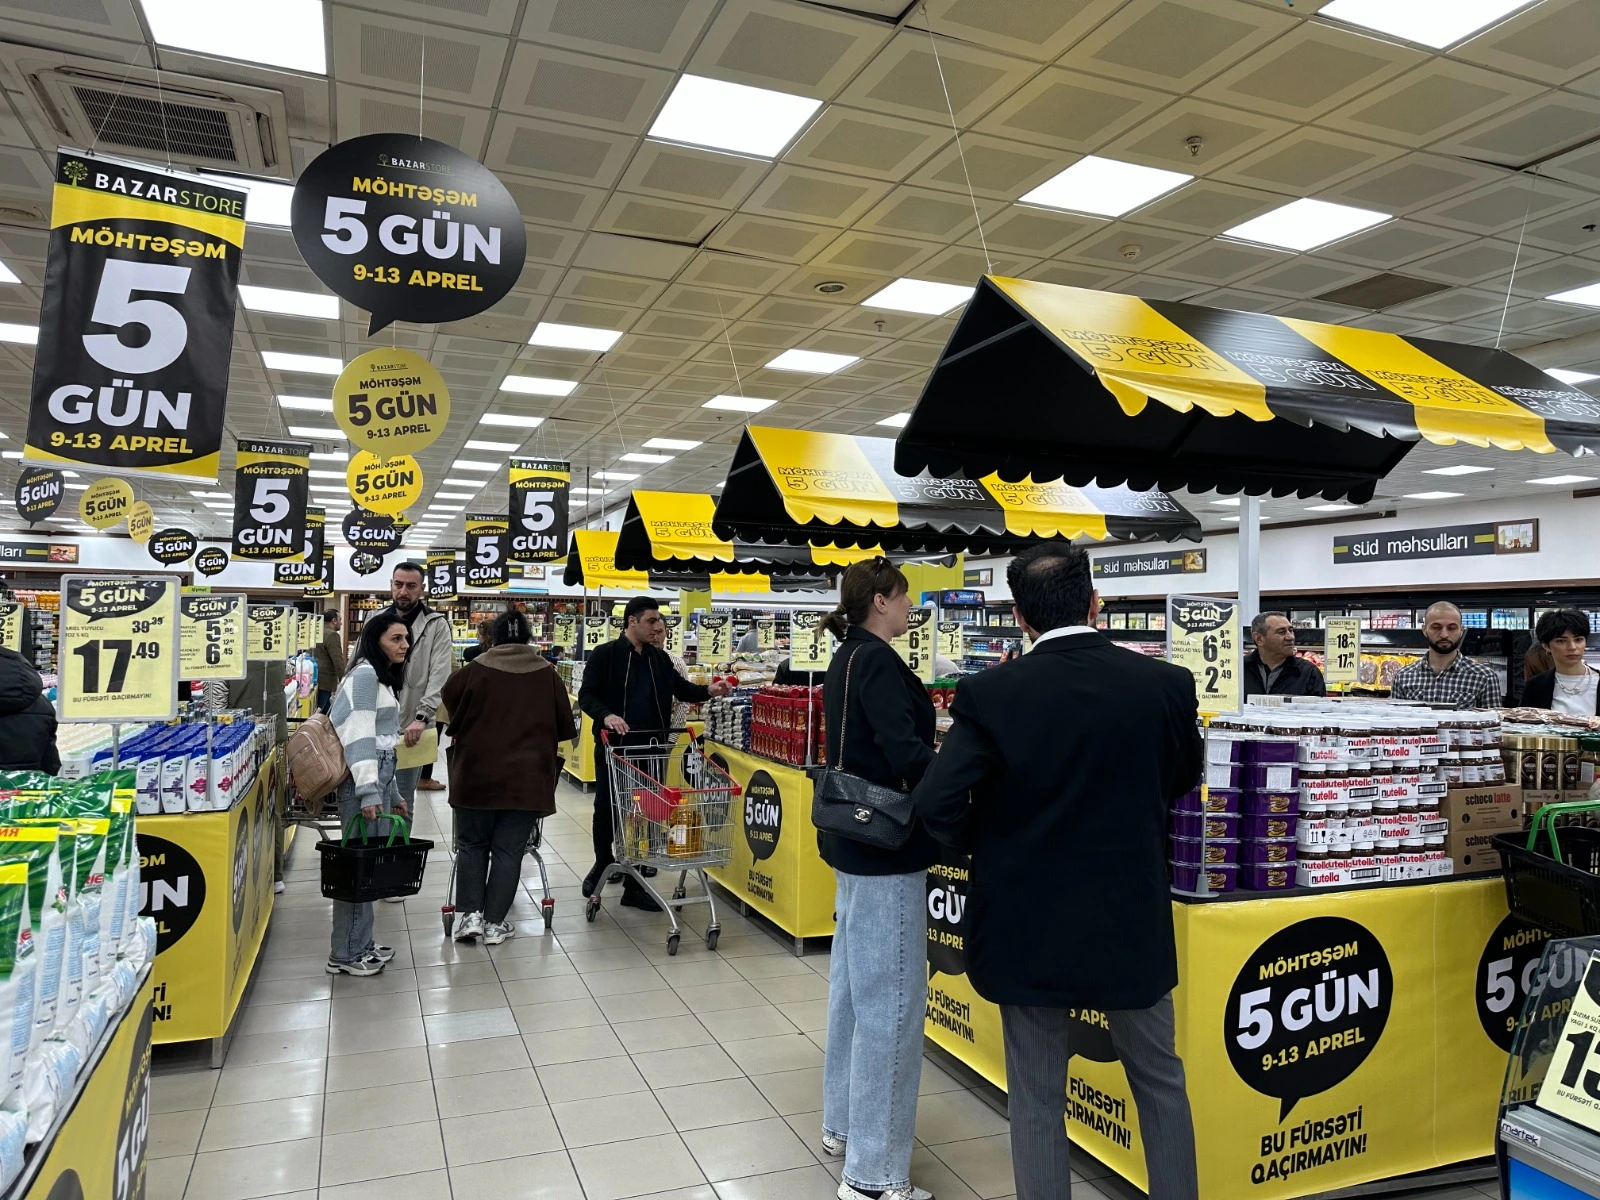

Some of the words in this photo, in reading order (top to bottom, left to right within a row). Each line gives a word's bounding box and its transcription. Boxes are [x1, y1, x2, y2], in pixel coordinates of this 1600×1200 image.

[391, 157, 452, 174] BAZARSTORE
[95, 172, 243, 218] BAZARSTORE
[352, 176, 478, 208] MÖHTƏŞƏM
[320, 196, 368, 255] 5
[379, 210, 501, 265] GÜN
[70, 226, 227, 260] MÖHTƏŞƏM
[353, 264, 400, 284] 9-13
[408, 269, 483, 292] APREL
[82, 258, 192, 374] 5
[1080, 341, 1124, 362] 5
[359, 376, 421, 390] MÖHTƏŞƏM
[1245, 363, 1288, 383] 5
[48, 379, 192, 431] GÜN
[348, 394, 372, 427] 5
[375, 390, 438, 421] GÜN
[366, 427, 390, 440] 9-13
[394, 423, 431, 437] APREL
[50, 430, 102, 449] 9-13
[109, 433, 194, 454] APREL
[251, 444, 309, 457] BAZARSTORE
[243, 466, 303, 476] MÖHTƏŞƏM
[355, 473, 370, 495] 5
[372, 470, 414, 490] GÜN
[515, 481, 565, 490] MÖHTƏŞƏM
[786, 476, 808, 491] 5
[813, 478, 880, 494] GÜN
[899, 485, 919, 499] 5
[923, 484, 985, 501] GÜN
[20, 486, 30, 506] 5
[31, 481, 60, 501] GÜN
[250, 478, 290, 523] 5
[364, 494, 380, 503] 9-13
[382, 490, 407, 500] APREL
[1001, 492, 1023, 506] 5
[1026, 492, 1086, 508] GÜN
[85, 501, 95, 516] 5
[97, 496, 127, 512] GÜN
[104, 511, 122, 519] APREL
[521, 491, 555, 531] 5
[130, 521, 136, 532] 5
[136, 516, 152, 529] GÜN
[348, 525, 361, 540] 5
[655, 528, 671, 538] 5
[238, 525, 292, 545] GÜN
[512, 533, 558, 550] GÜN
[1352, 539, 1379, 557] süd
[1387, 533, 1468, 554] məhsulları
[154, 542, 164, 554] 5
[165, 541, 192, 552] GÜN
[475, 536, 500, 565] 5
[198, 558, 206, 568] 5
[206, 557, 225, 566] GÜN
[469, 566, 502, 579] GÜN
[1104, 560, 1120, 574] süd
[1123, 558, 1169, 573] məhsulları
[433, 565, 450, 585] 5
[79, 588, 97, 607] 5
[99, 586, 145, 604] GÜN
[430, 585, 453, 595] GÜN
[188, 602, 199, 613] 5
[200, 601, 227, 611] GÜN
[1179, 608, 1190, 622] 5
[1191, 607, 1220, 621] GÜN
[797, 615, 804, 623] 5
[1310, 750, 1338, 760] nutella
[1310, 791, 1338, 801] nutella
[1381, 788, 1408, 798] nutella
[1465, 794, 1493, 806] schoco
[1494, 792, 1511, 803] latte
[745, 797, 753, 826] 5
[755, 799, 779, 827] GÜN
[1381, 827, 1410, 838] nutella
[1311, 873, 1340, 884] nutella
[928, 885, 967, 924] GÜ
[1259, 940, 1359, 981] MÖHTƏŞƏM
[1485, 956, 1515, 1013] 5
[935, 989, 970, 1023] FÜRSƏTİ
[1236, 986, 1273, 1050] 5
[1281, 968, 1380, 1032] GÜN
[925, 1003, 975, 1044] AÇIRMAYIN!
[1262, 1045, 1299, 1071] 9-13
[1305, 1026, 1366, 1059] APREL
[1069, 1076, 1127, 1123] FÜRSƏTİ
[1260, 1131, 1285, 1157] BU
[1290, 1105, 1363, 1149] FÜRSƏTİ
[1501, 1121, 1539, 1146] martek
[1251, 1133, 1367, 1185] QAÇIRMAYIN!
